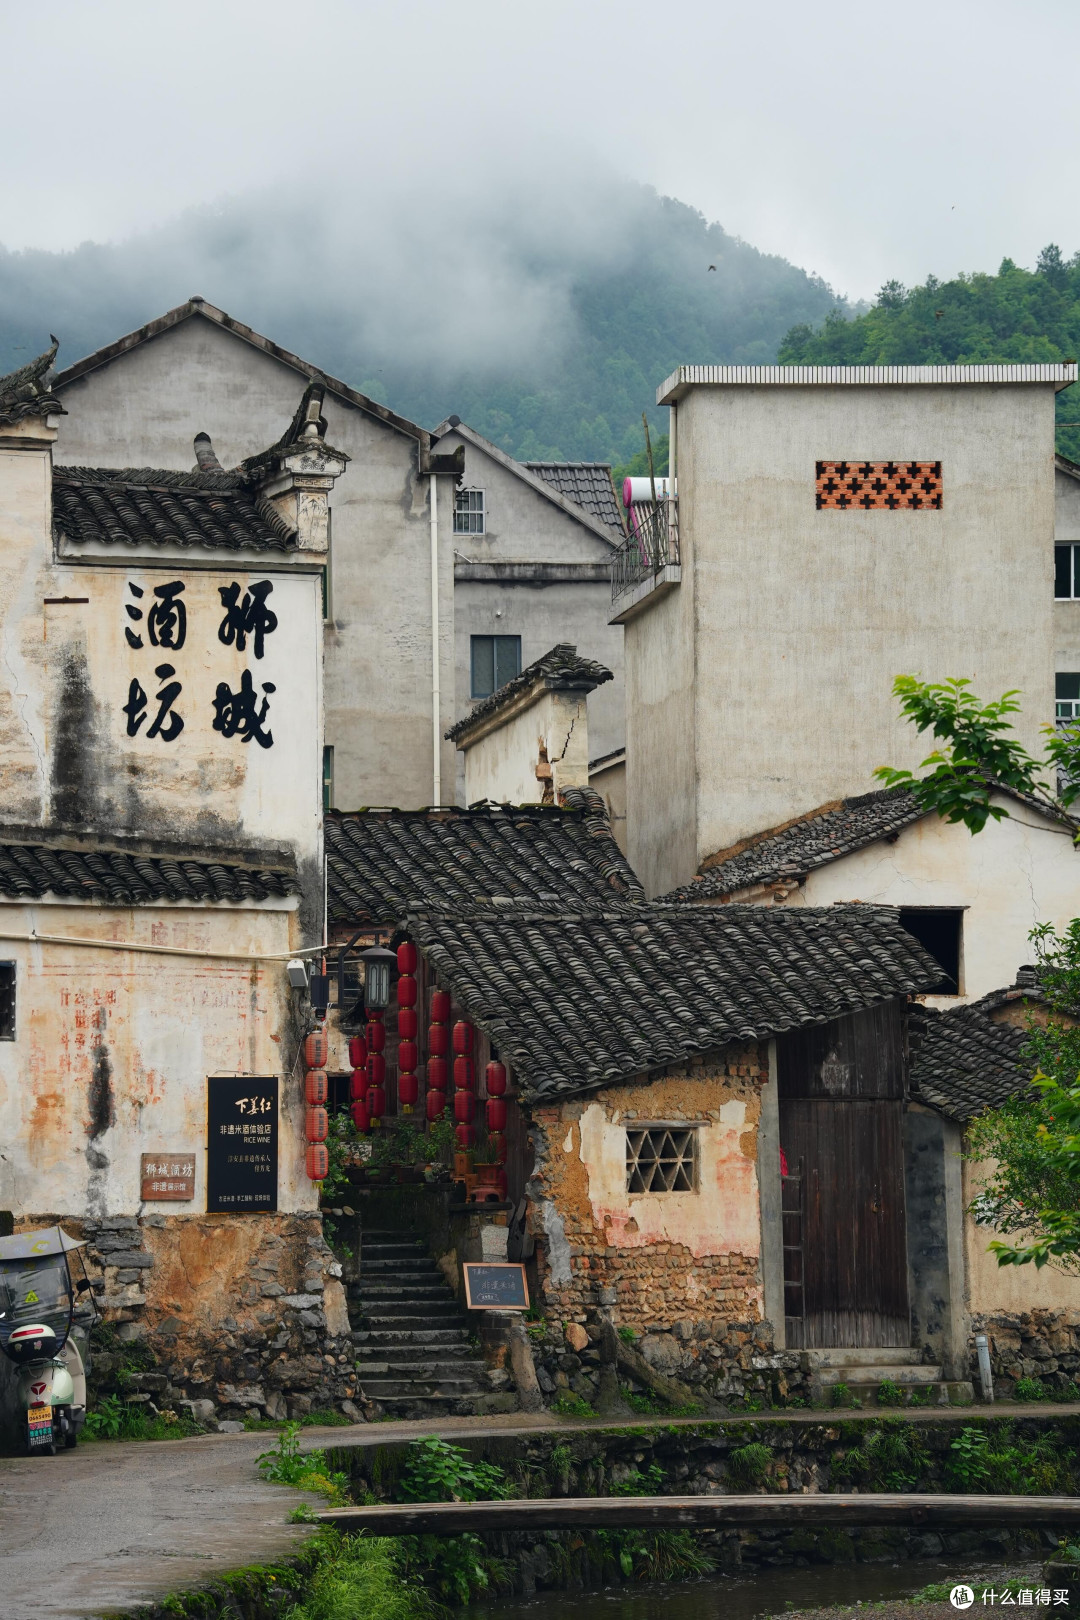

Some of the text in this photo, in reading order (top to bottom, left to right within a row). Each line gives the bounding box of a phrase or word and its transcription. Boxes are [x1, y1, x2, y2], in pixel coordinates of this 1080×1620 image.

[122, 580, 187, 742] 酒坊
[235, 1096, 271, 1115] 下姜红
[219, 1124, 272, 1135] 非遗米酒体验店
[243, 1136, 271, 1144] RICE WINE
[146, 1163, 194, 1177] 狮城酒坊
